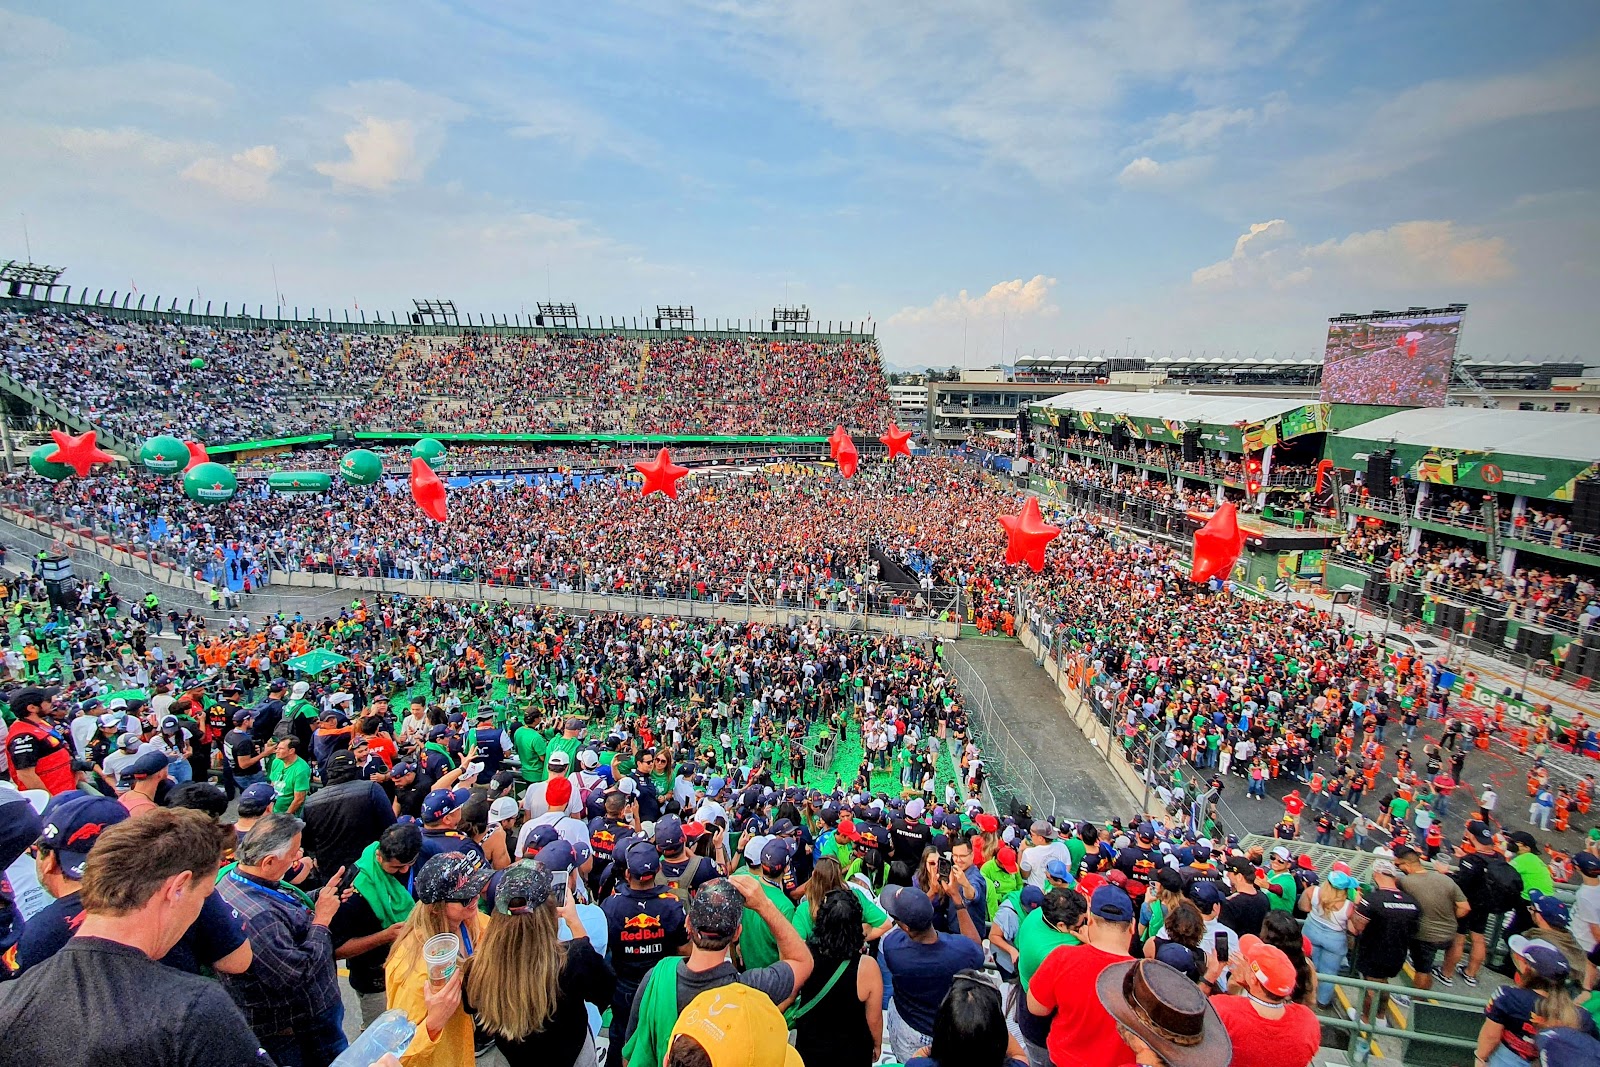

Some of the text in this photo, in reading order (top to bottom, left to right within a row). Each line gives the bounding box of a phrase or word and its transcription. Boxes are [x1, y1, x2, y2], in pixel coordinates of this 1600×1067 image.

[896, 829, 922, 838] PETRONAS
[620, 928, 665, 941] Red Bull
[624, 945, 652, 954] Mobil
